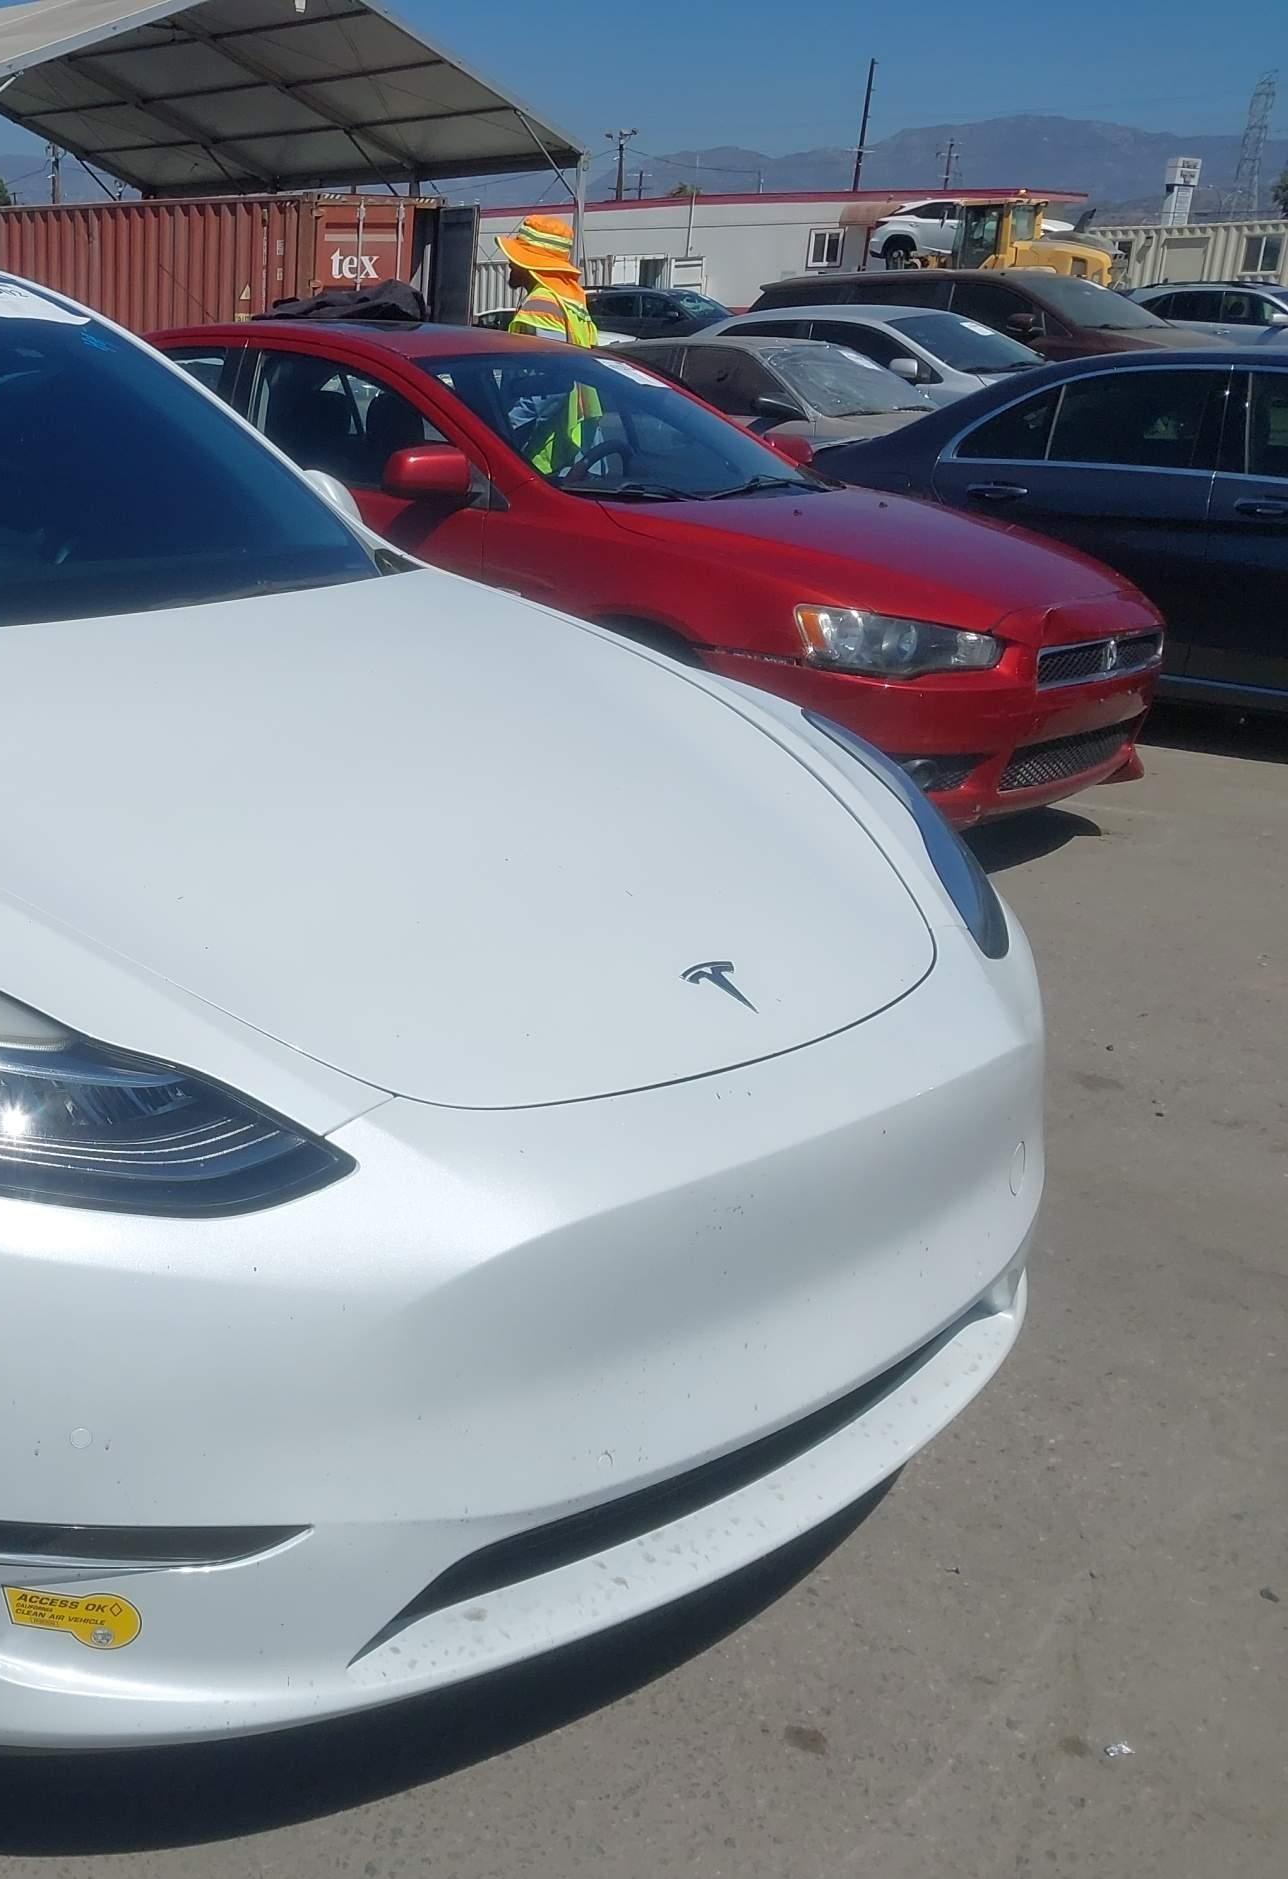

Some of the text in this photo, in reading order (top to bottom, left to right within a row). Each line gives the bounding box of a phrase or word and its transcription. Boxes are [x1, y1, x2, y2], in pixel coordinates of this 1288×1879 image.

[330, 248, 380, 280] tex
[17, 1593, 108, 1613] ACCESS OK
[15, 1608, 47, 1618] CLEAN
[48, 1613, 65, 1622] AIR
[68, 1616, 106, 1626] VEHICLE
